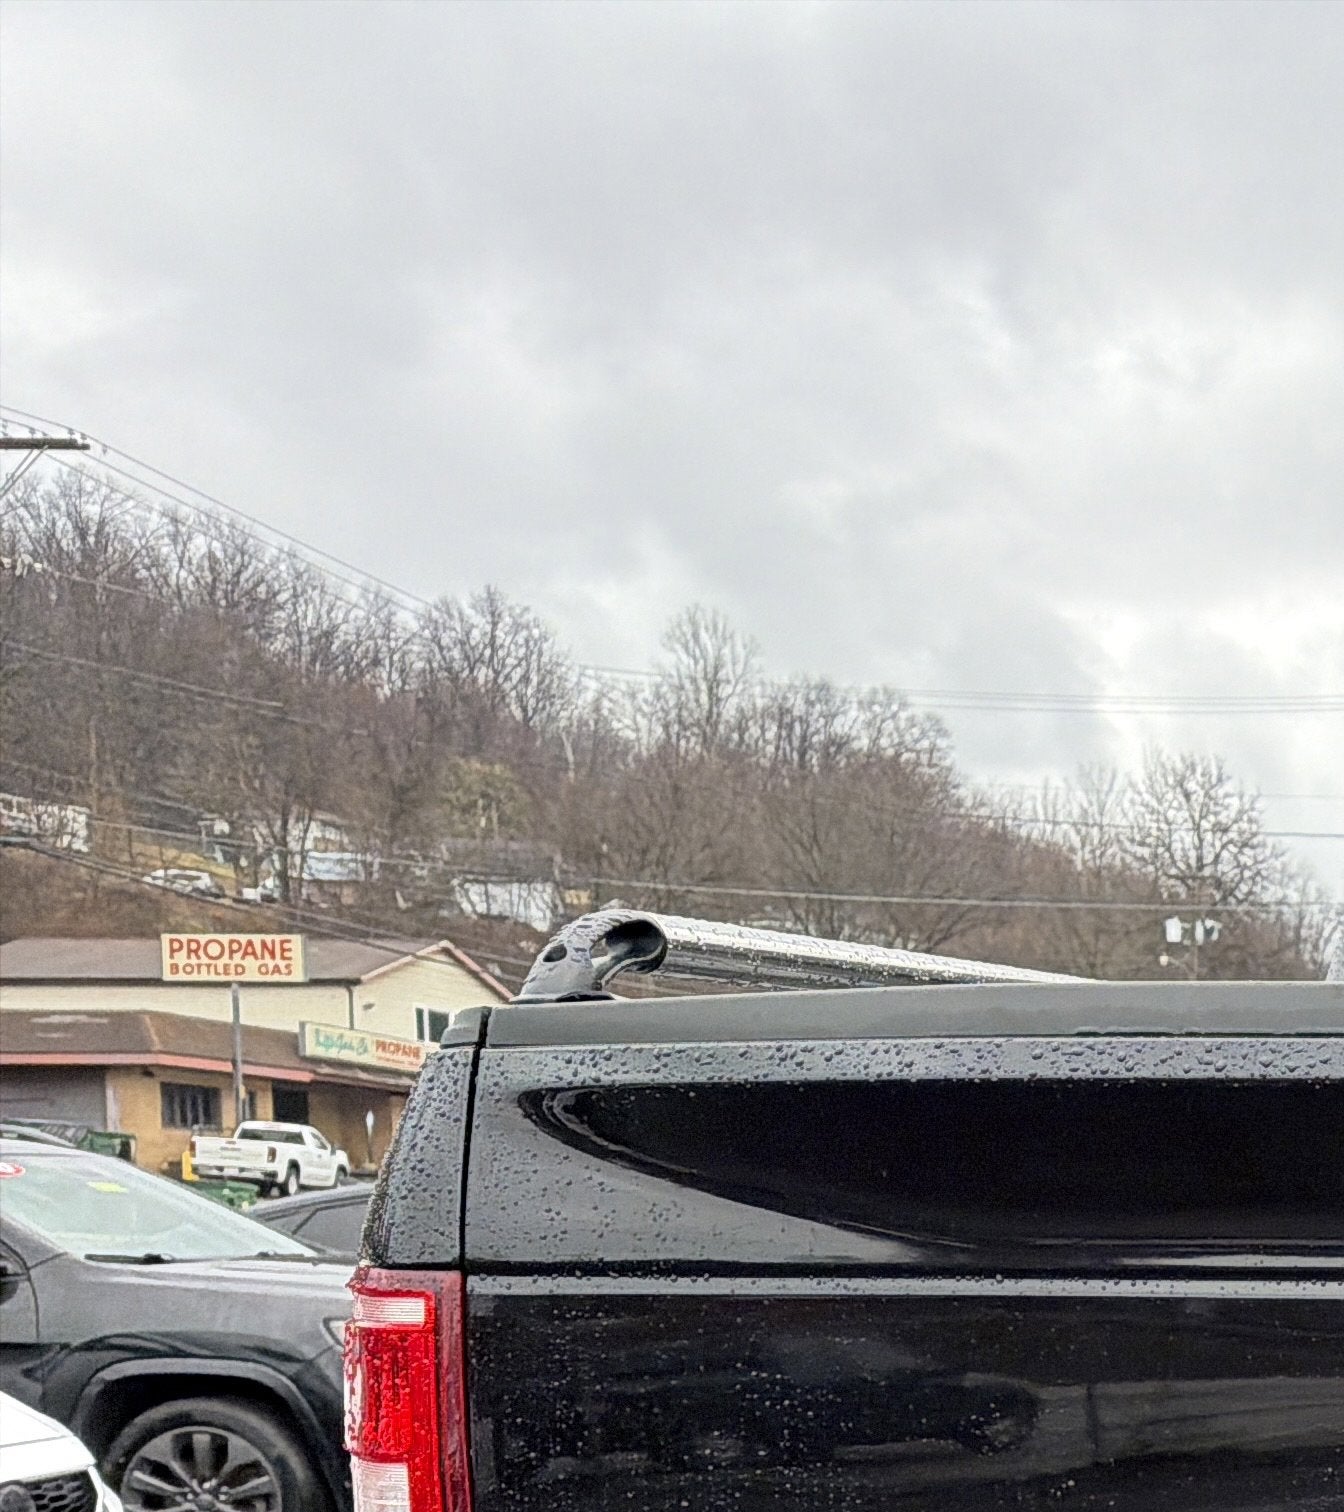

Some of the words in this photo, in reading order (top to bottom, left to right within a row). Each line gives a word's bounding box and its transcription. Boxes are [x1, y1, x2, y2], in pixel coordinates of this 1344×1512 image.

[168, 937, 293, 961] PROPANE
[169, 963, 246, 976] BOTTLED
[257, 963, 293, 976] GAS
